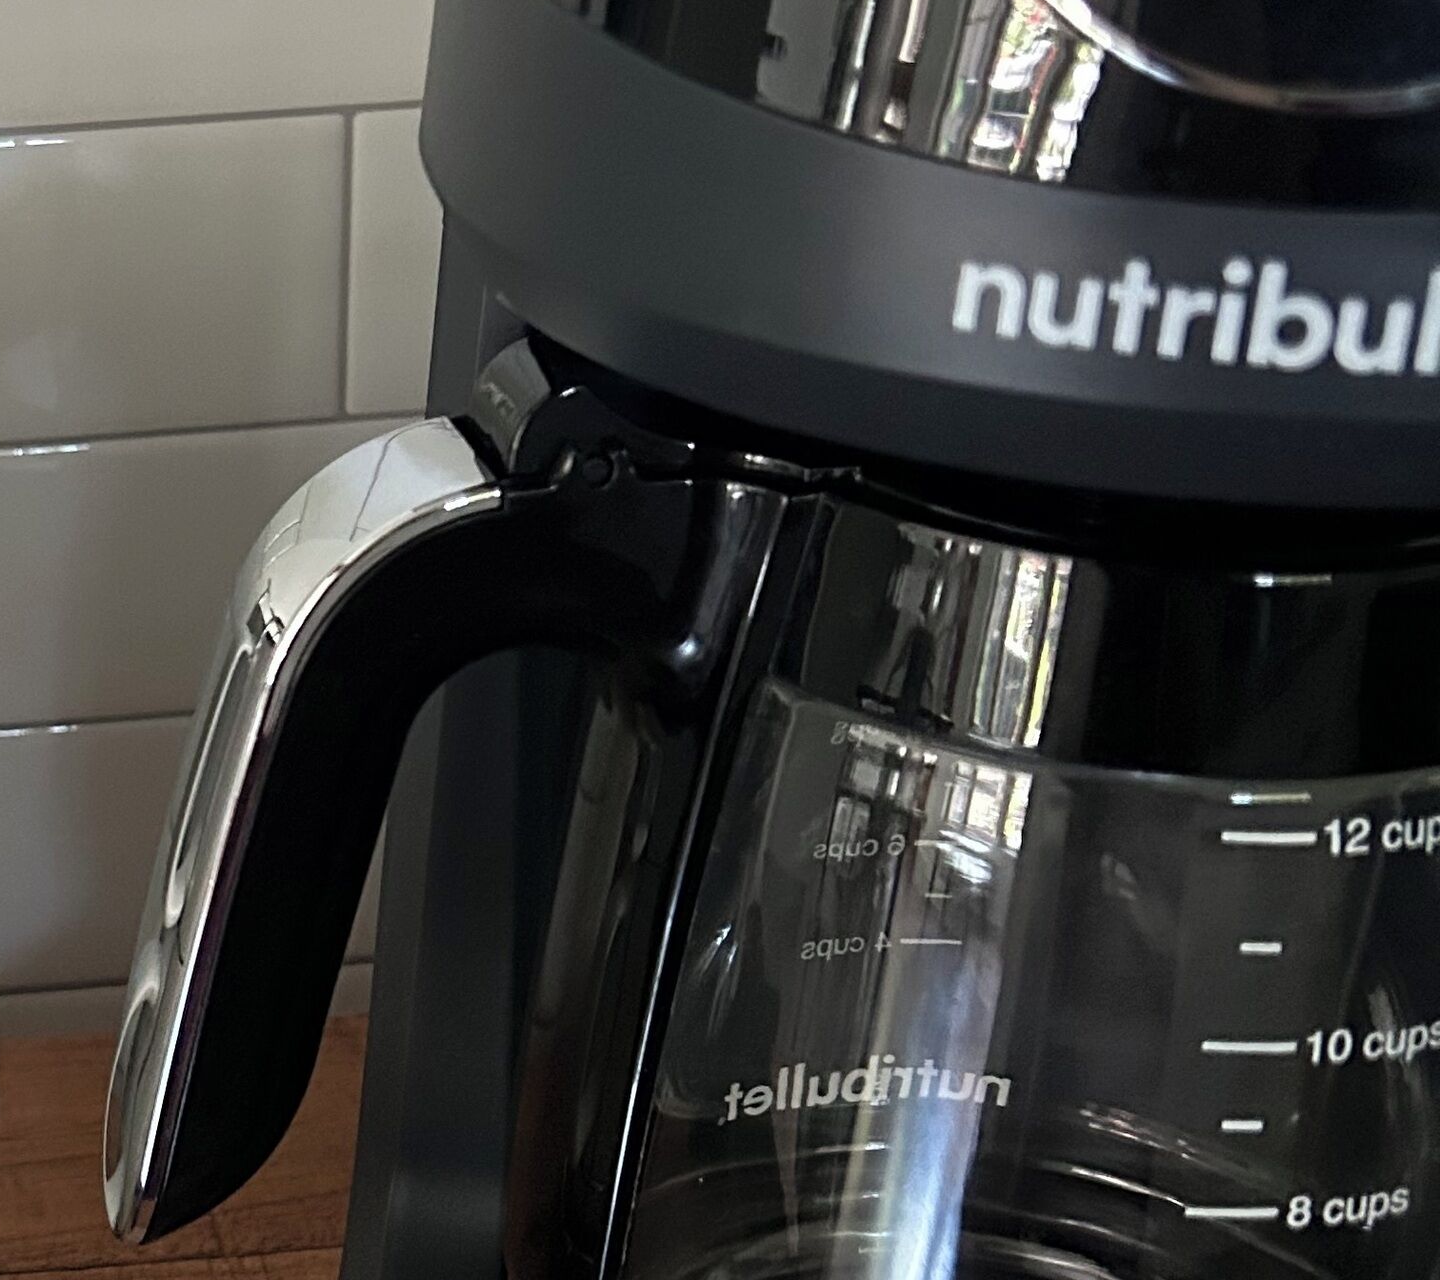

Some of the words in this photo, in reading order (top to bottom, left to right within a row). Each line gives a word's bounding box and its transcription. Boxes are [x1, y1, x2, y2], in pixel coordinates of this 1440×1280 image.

[1323, 817, 1371, 857] 12
[1306, 1027, 1353, 1067] 10
[1286, 1194, 1312, 1229] 8
[1322, 1186, 1410, 1230] cups
